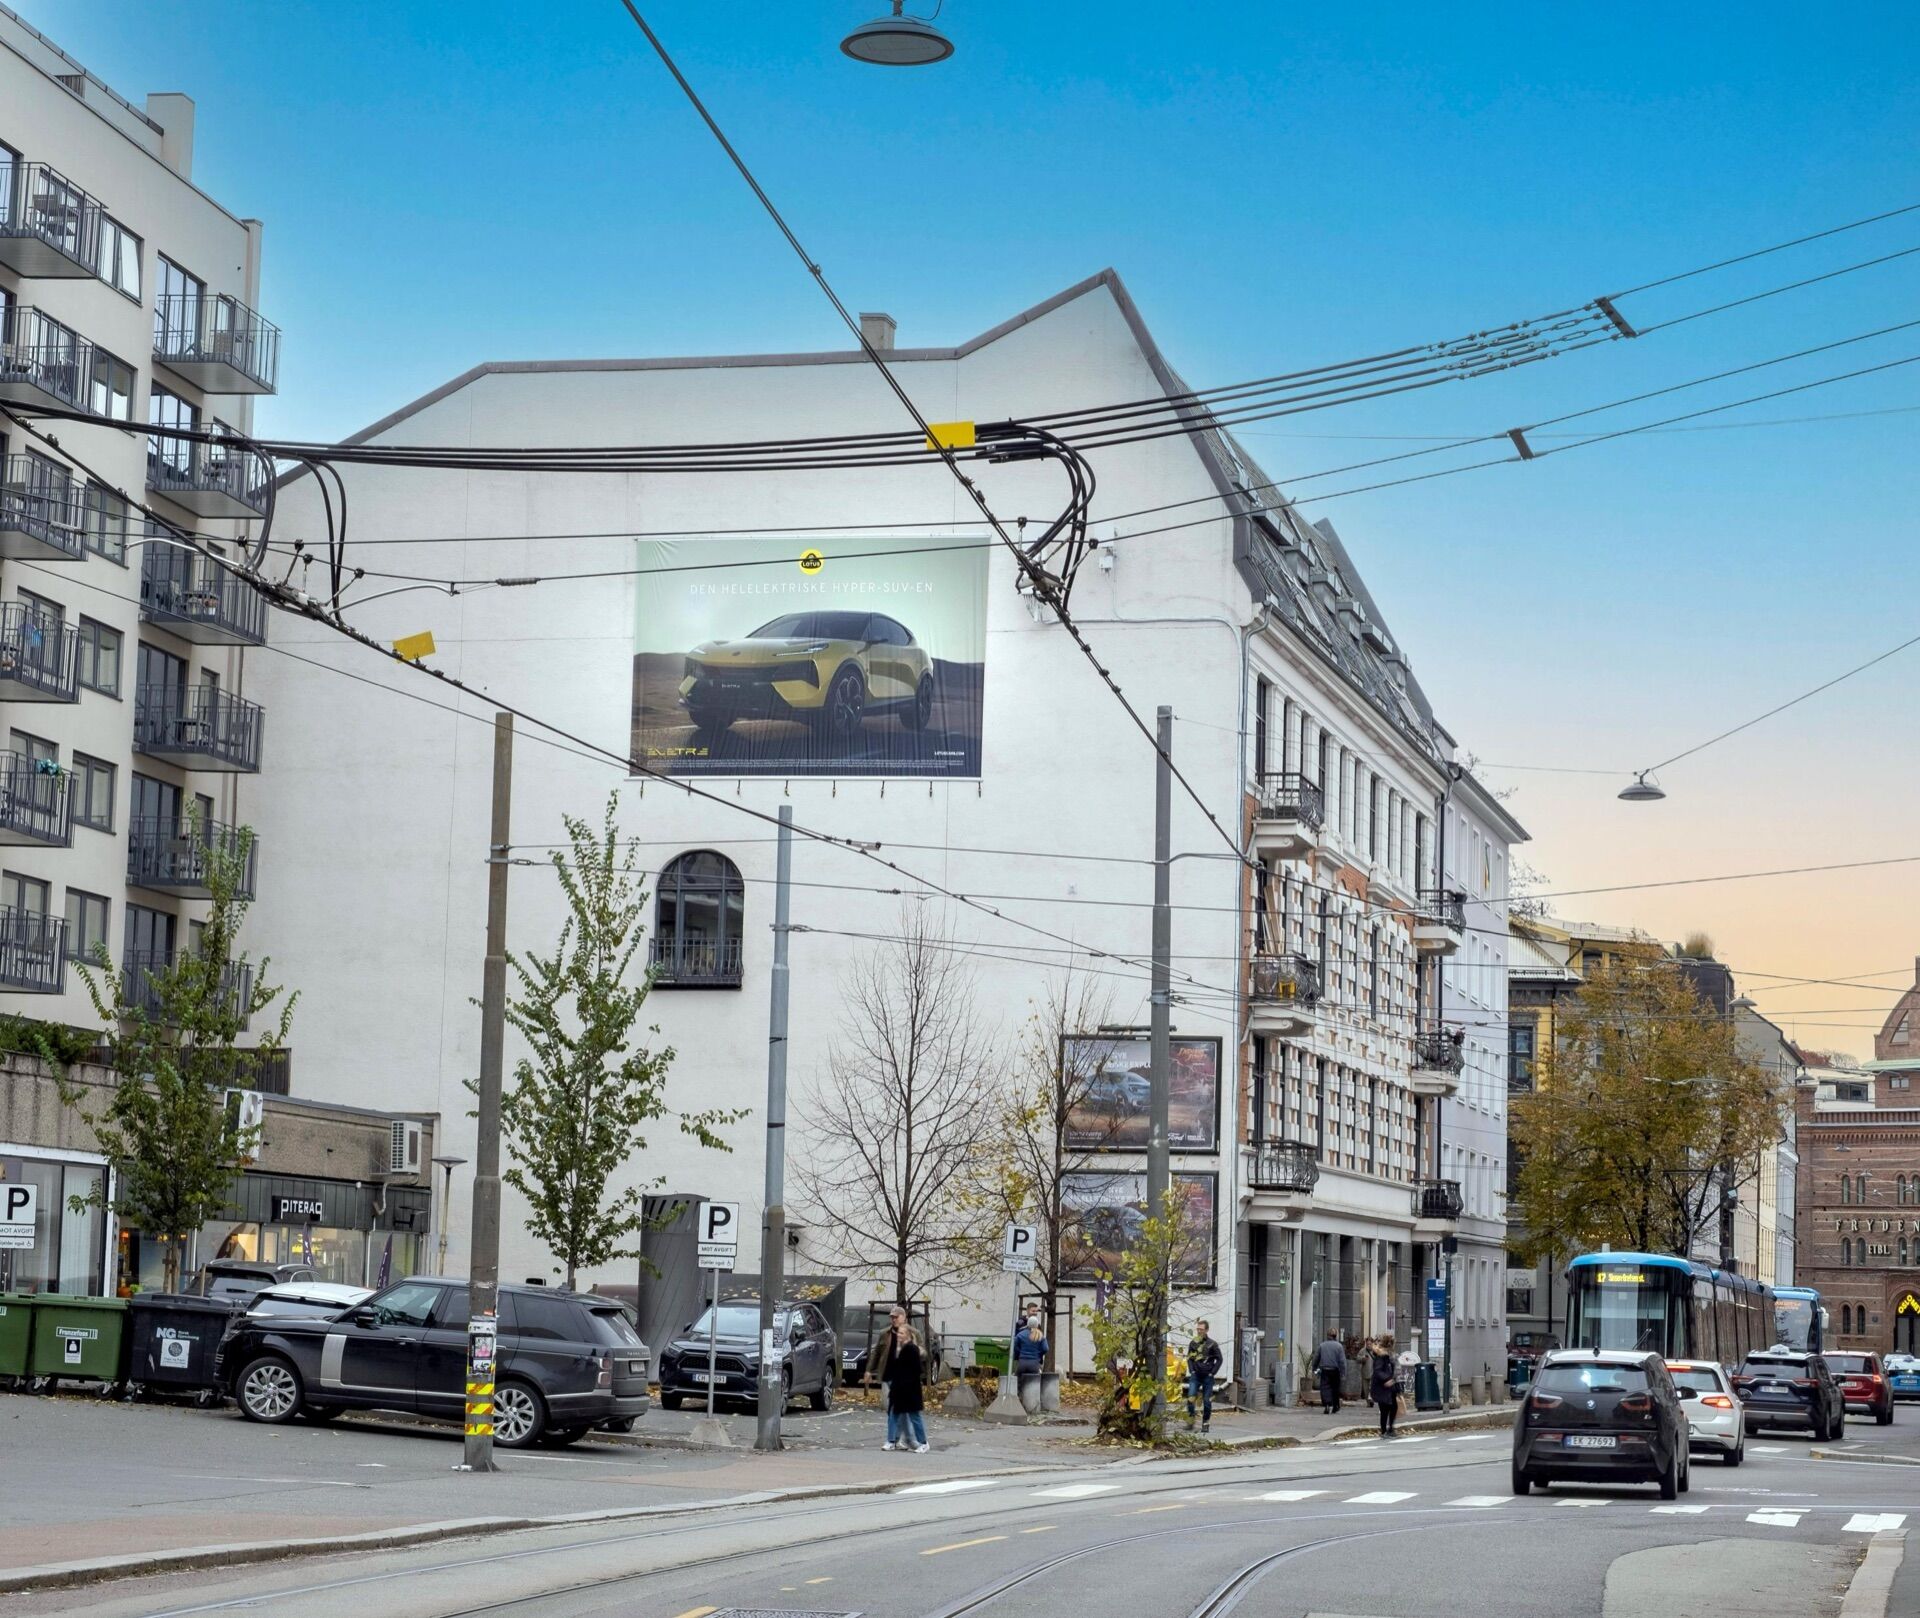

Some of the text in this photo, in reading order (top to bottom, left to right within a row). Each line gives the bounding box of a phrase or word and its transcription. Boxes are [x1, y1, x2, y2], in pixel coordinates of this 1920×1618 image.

[690, 582, 933, 594] DEN HELELEKTRISKE HYPER-SUV-EN
[7, 1187, 30, 1220] P
[281, 1200, 323, 1221] PITERAQ
[708, 1206, 731, 1239] P
[1012, 1229, 1030, 1252] P
[1868, 1244, 1890, 1255] ETBL.
[1597, 1273, 1606, 1283] 17
[156, 1327, 177, 1339] NG
[1588, 1437, 1614, 1446] 27692
